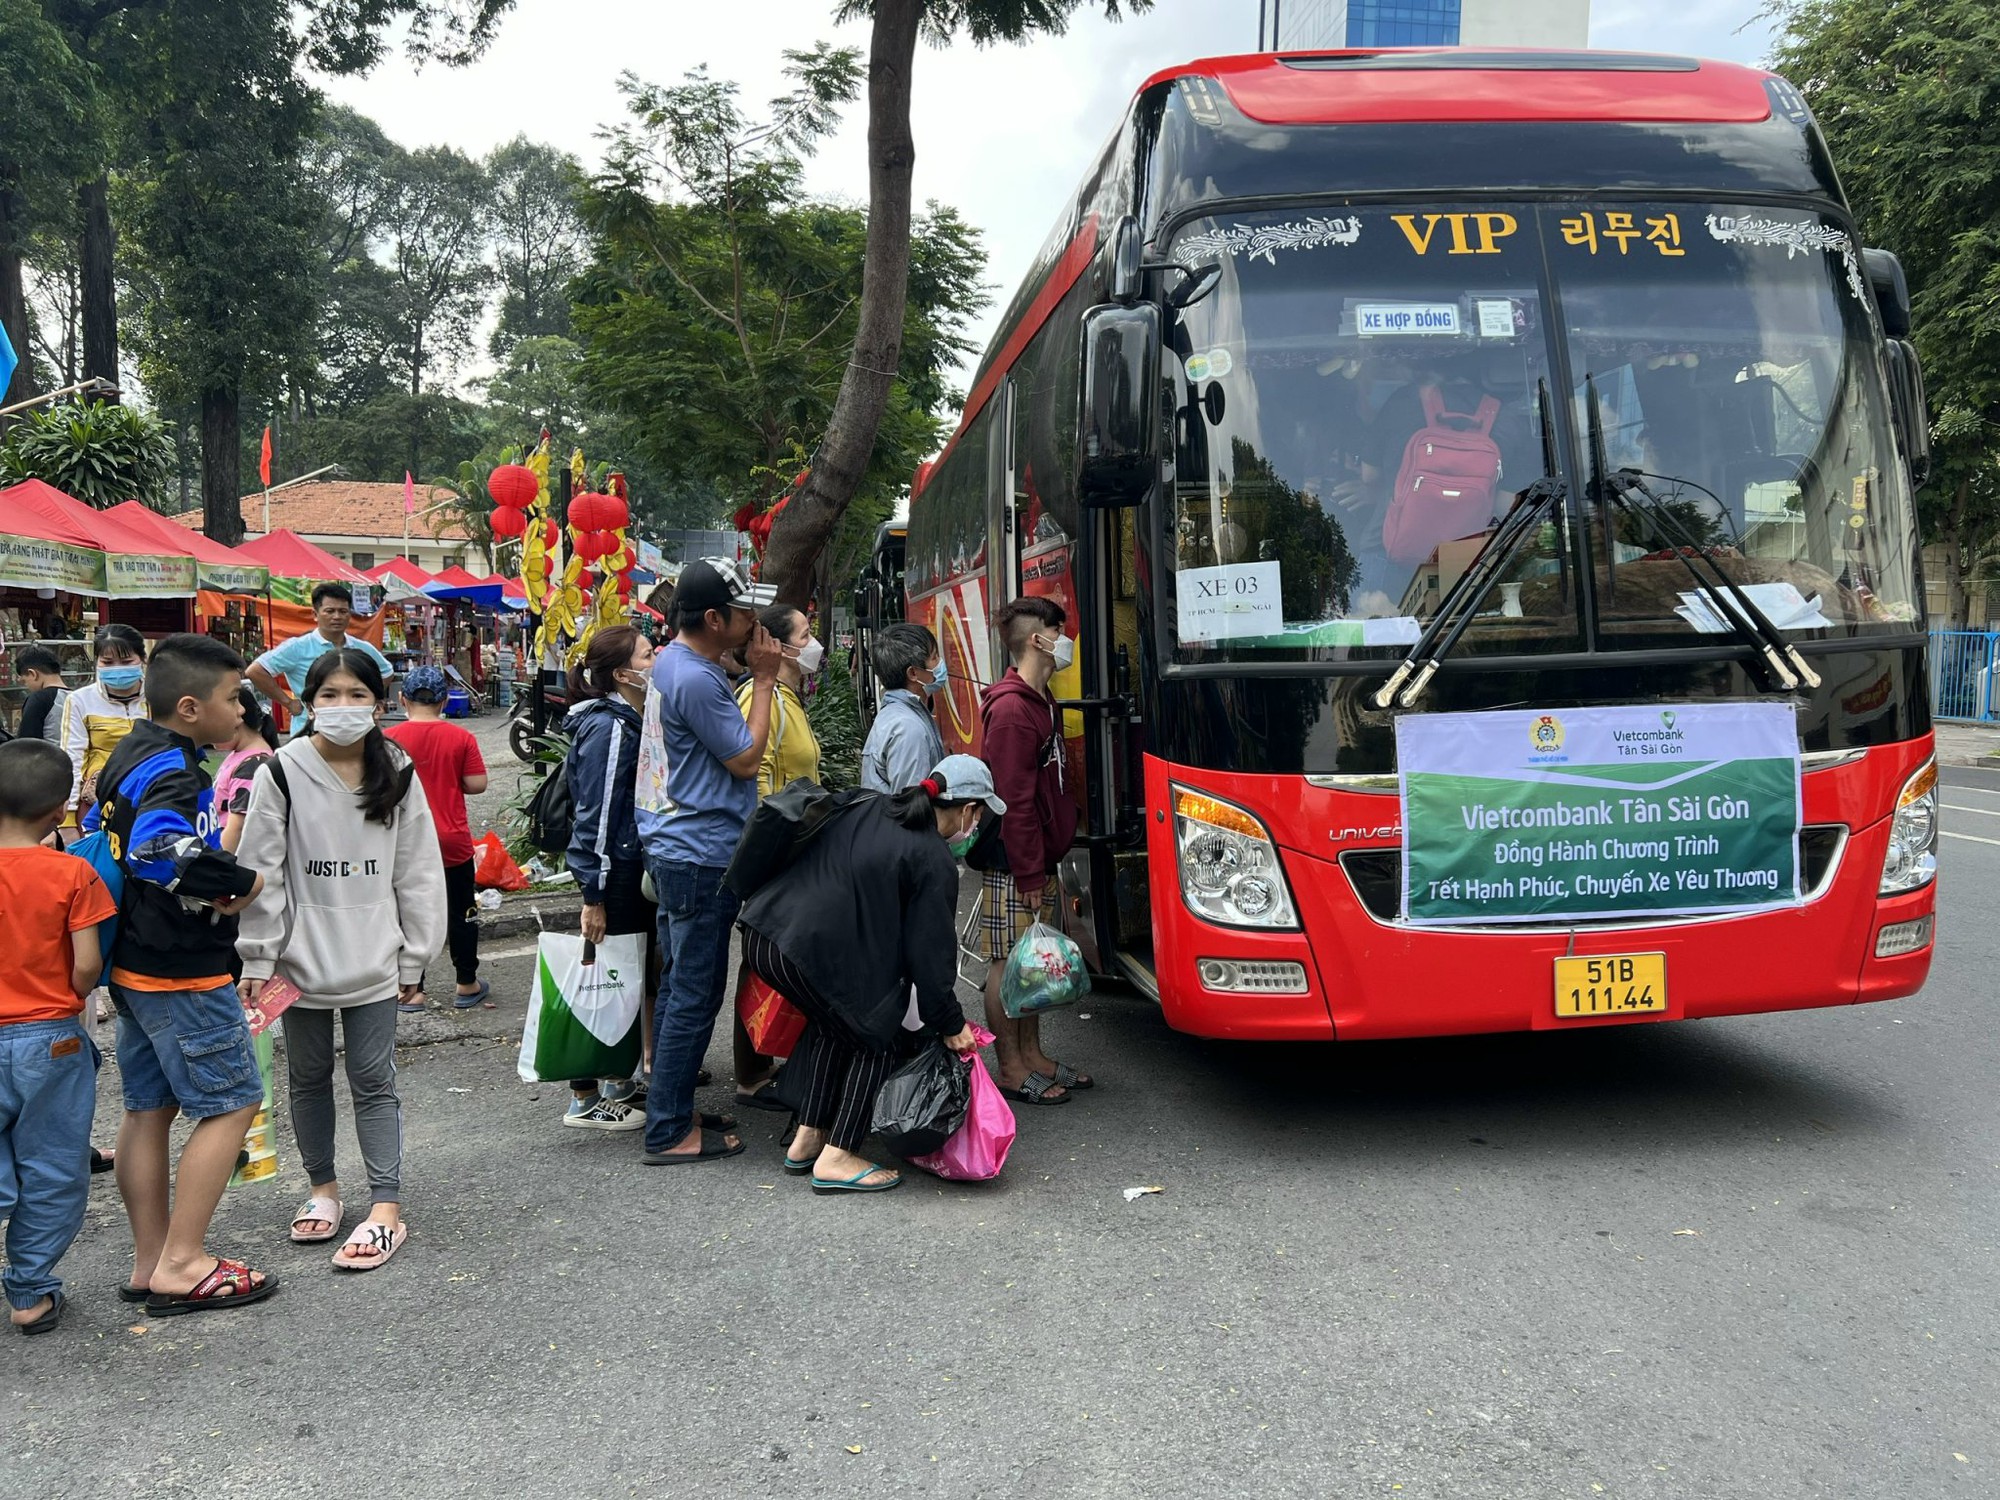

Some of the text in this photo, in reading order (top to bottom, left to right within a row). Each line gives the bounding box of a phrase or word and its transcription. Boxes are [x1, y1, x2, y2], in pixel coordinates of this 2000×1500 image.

[1390, 213, 1518, 255] VIP
[1560, 211, 1686, 257] 리무진
[1364, 313, 1381, 328] XE
[1385, 311, 1411, 330] HỢP
[1197, 576, 1258, 598] XE 03
[1197, 608, 1216, 616] HCM
[1613, 729, 1684, 742] Vietcombank
[1618, 743, 1683, 756] Tân Sài Gòn
[1461, 795, 1750, 830] Vietcombank Tân Sài Gòn
[1494, 835, 1719, 867] Đồng Hành Chương Trình
[305, 860, 337, 877] JUST
[1428, 868, 1779, 904] Tết Hạnh Phúc, Chuyến Xe Yêu Thương
[1587, 959, 1634, 984] 51B
[1571, 985, 1654, 1012] 111.44
